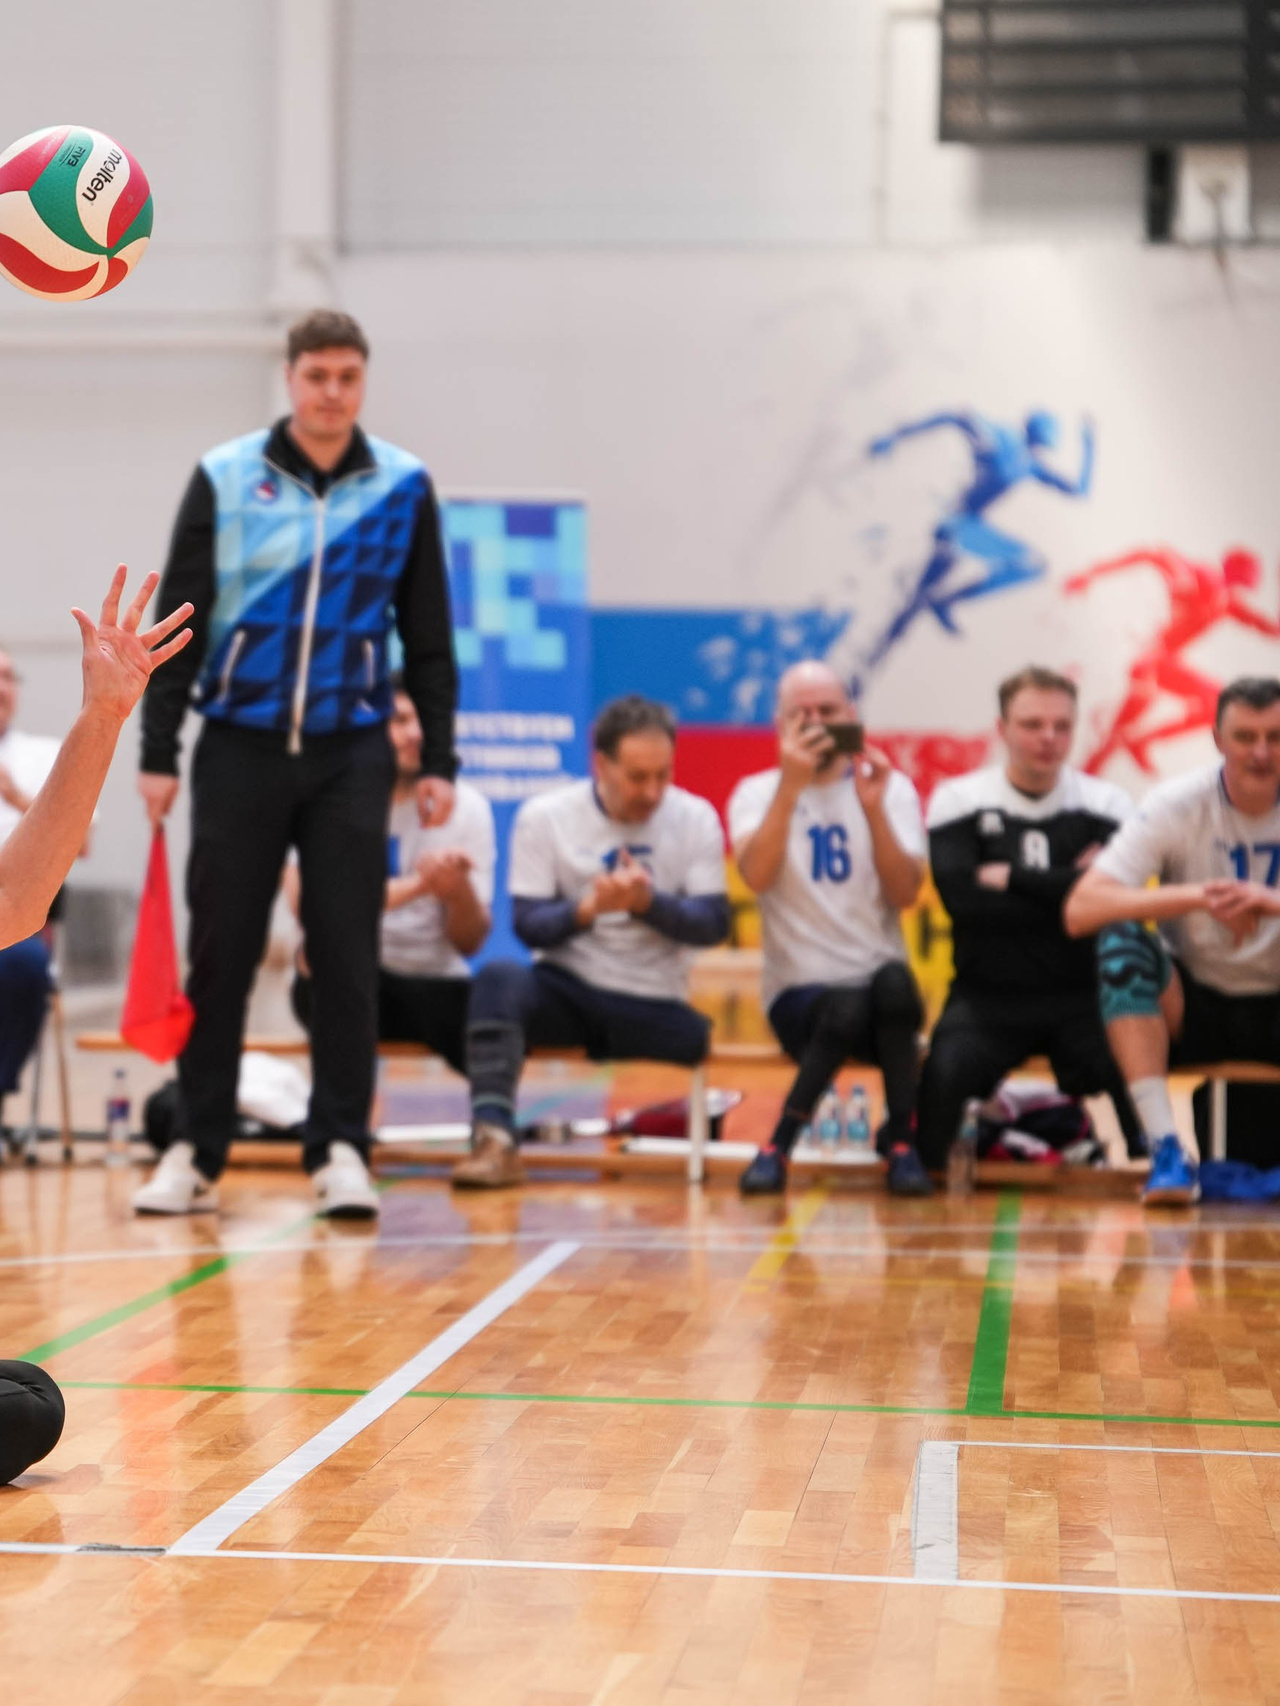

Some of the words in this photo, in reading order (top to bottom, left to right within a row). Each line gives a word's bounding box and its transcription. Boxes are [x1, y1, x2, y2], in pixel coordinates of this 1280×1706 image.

[67, 146, 86, 167] FIVB
[81, 149, 122, 201] molten
[807, 823, 851, 883] 16
[1230, 841, 1280, 888] 17
